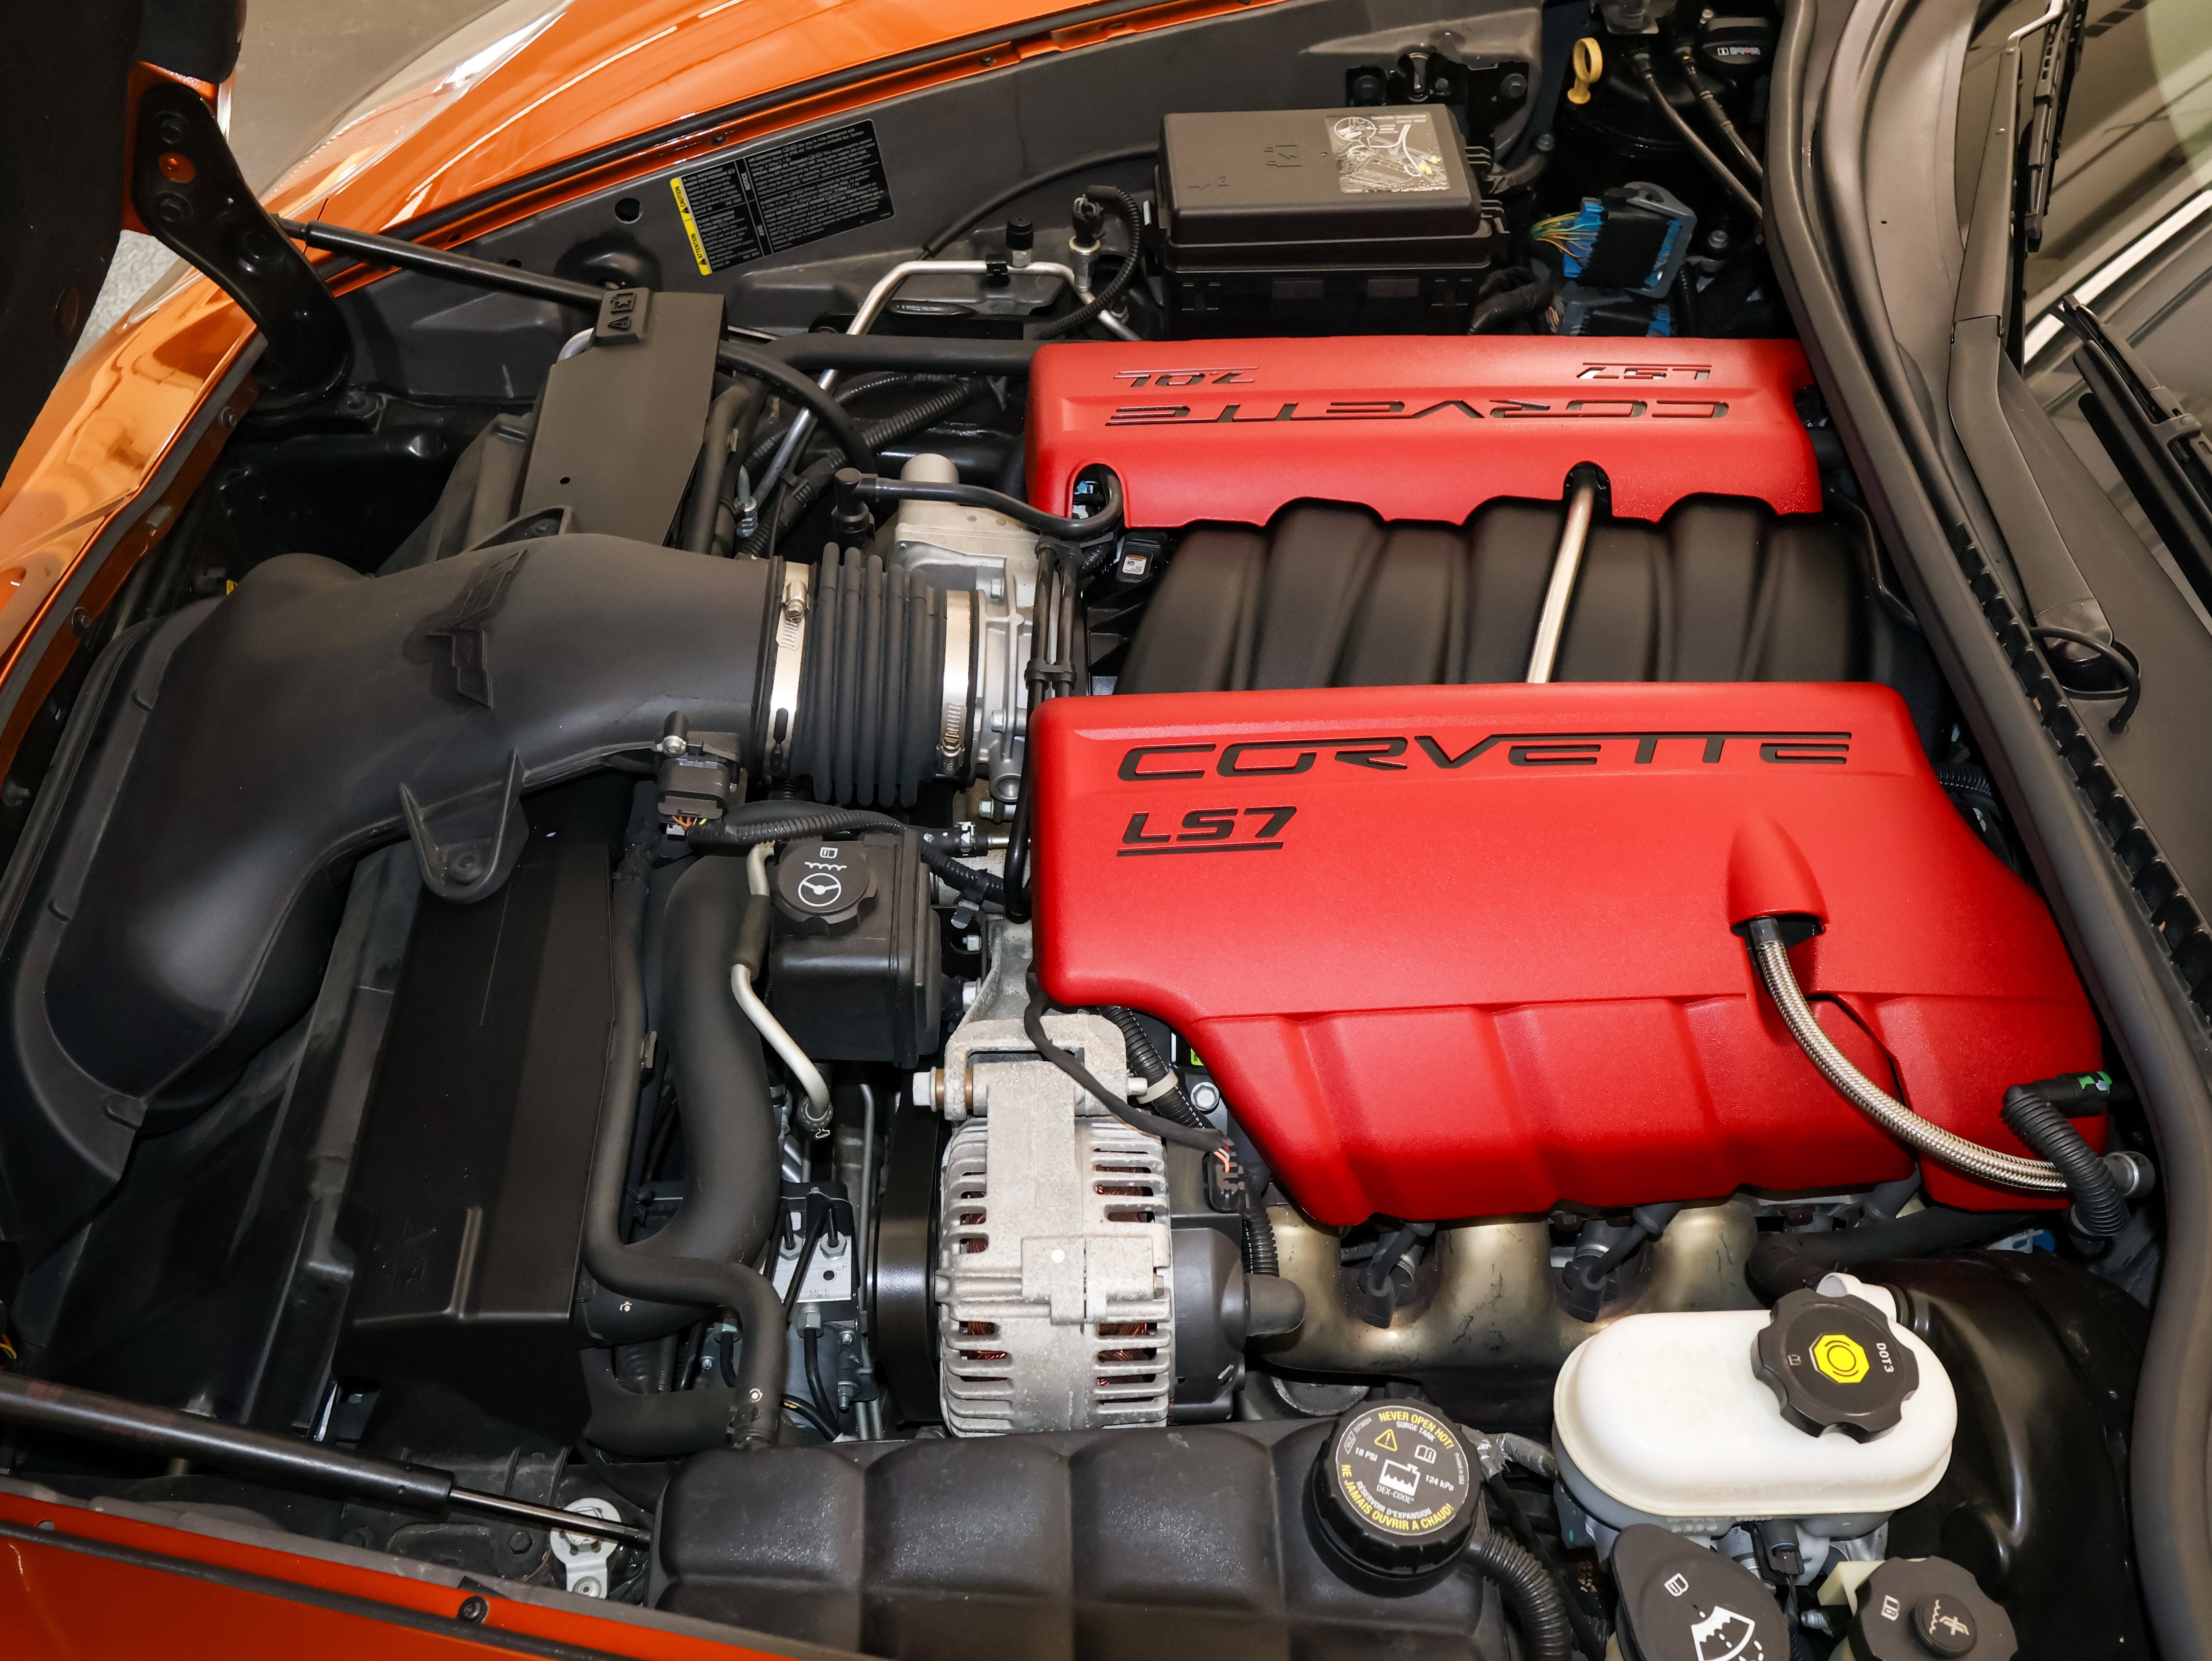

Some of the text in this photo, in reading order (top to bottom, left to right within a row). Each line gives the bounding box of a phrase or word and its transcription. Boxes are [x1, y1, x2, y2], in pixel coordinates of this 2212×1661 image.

[675, 186, 686, 207] CAUTION
[690, 233, 703, 258] ATTENTION
[1576, 367, 1711, 380] LS7
[1105, 399, 1730, 426] CORVETTE
[1118, 731, 1852, 782] CORVETTE
[1122, 805, 1297, 845] LS7
[1378, 1411, 1455, 1449] NEVER OPEN HOT!
[1396, 1421, 1436, 1442] SURGE TANK
[1355, 1446, 1378, 1462] 18 PSI
[1341, 1464, 1352, 1478] NE
[1425, 1474, 1455, 1492] 124 kPa
[1344, 1478, 1372, 1515] JAMAIS
[1372, 1510, 1409, 1531] OUVRIR
[1386, 1507, 1432, 1520] D'EXPANSION
[1420, 1502, 1455, 1529] CHAUD!
